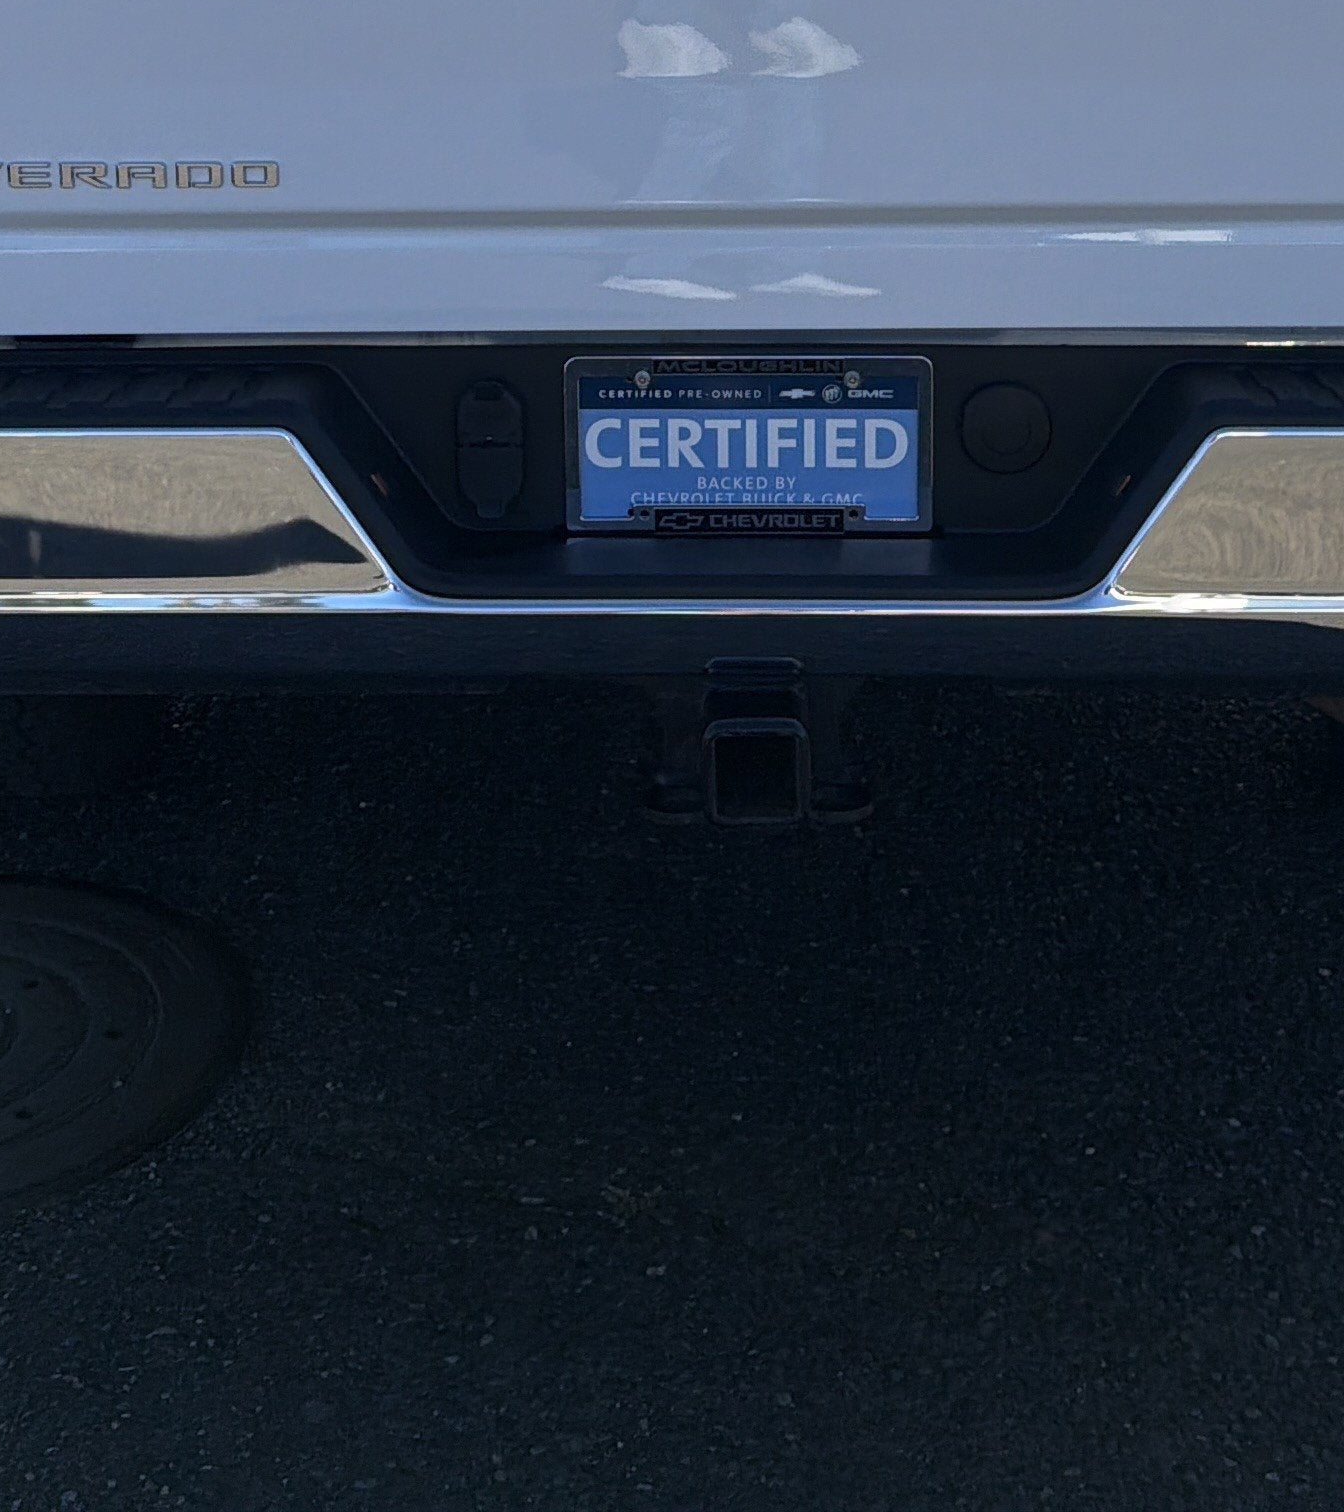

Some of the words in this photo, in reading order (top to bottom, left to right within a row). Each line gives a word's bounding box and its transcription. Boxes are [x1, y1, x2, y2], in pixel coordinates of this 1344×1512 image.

[655, 359, 842, 374] MCLOUGHLIN
[598, 388, 672, 400] CERTIFIED
[677, 388, 763, 400] PRE-OWNED
[847, 389, 895, 400] GMC
[585, 417, 909, 469] CERTIFIED
[697, 476, 768, 490] BACKED
[775, 475, 797, 490] BY
[630, 491, 735, 504] CHEVROLET
[821, 491, 863, 504] GMC
[709, 513, 840, 529] CHEVROLET
